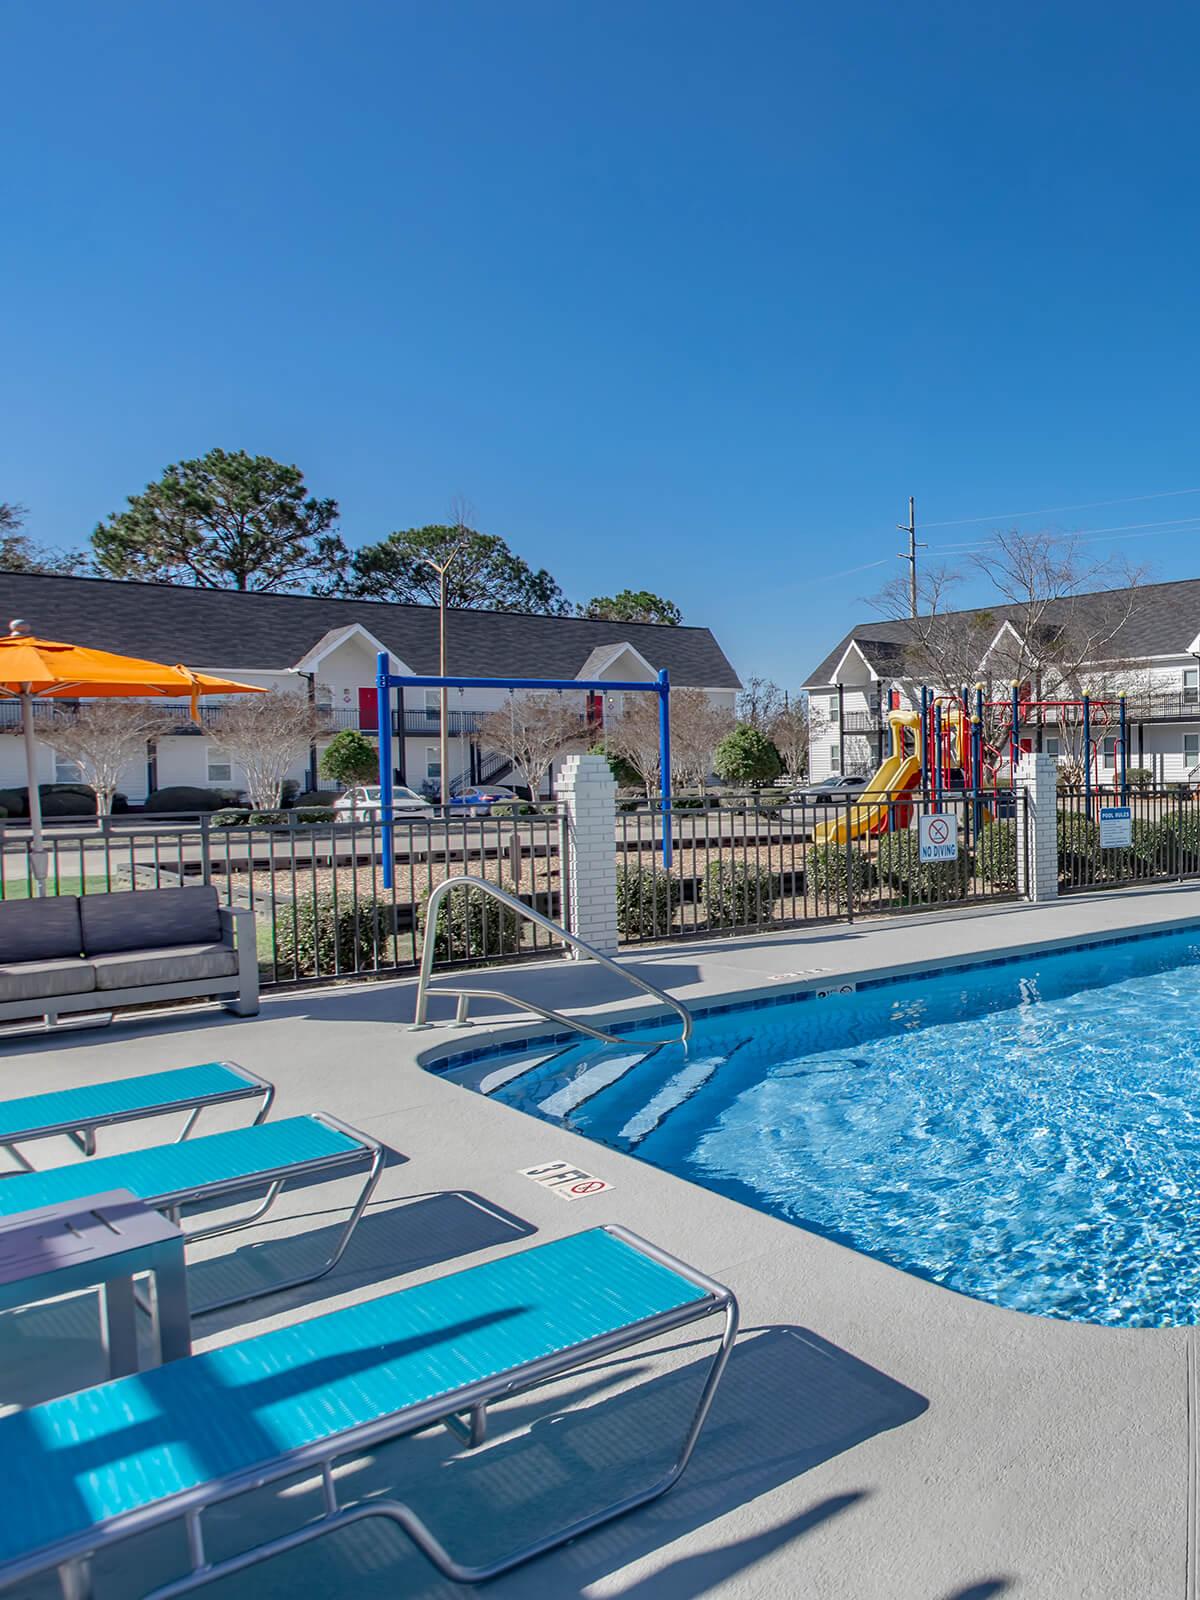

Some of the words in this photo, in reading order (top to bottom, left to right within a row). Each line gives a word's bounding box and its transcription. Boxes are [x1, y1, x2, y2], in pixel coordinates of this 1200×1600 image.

[922, 846, 932, 858] NO
[933, 844, 956, 857] DIVING
[526, 1163, 567, 1175] 3
[539, 1169, 591, 1186] FT
